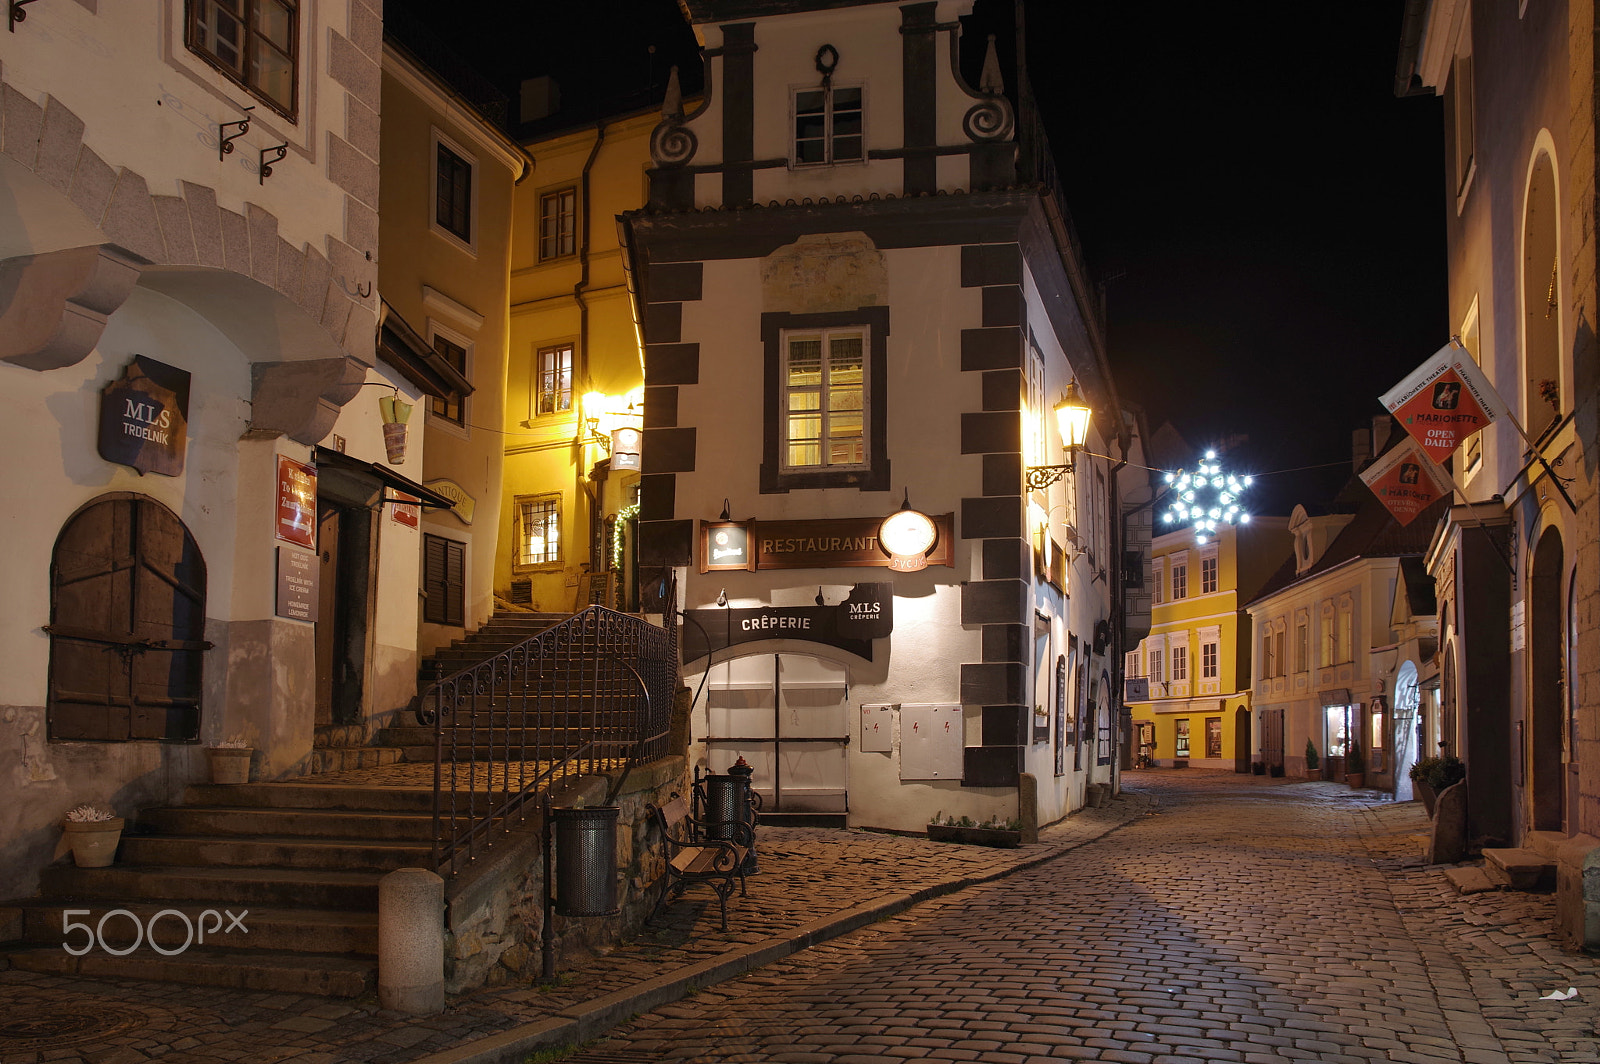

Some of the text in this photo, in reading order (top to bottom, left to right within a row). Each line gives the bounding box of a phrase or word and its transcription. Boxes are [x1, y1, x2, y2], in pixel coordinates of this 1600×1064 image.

[1397, 380, 1427, 405] MARIONETTE
[123, 398, 171, 429] MLS
[1416, 413, 1479, 424] MARIONETTE
[123, 422, 169, 446] TRDELNÍK
[1427, 429, 1456, 439] OPEN
[1424, 437, 1456, 448] DAILY
[763, 535, 878, 554] RESTAURANT
[849, 602, 881, 614] MLS
[741, 615, 811, 631] CRÊPERIE
